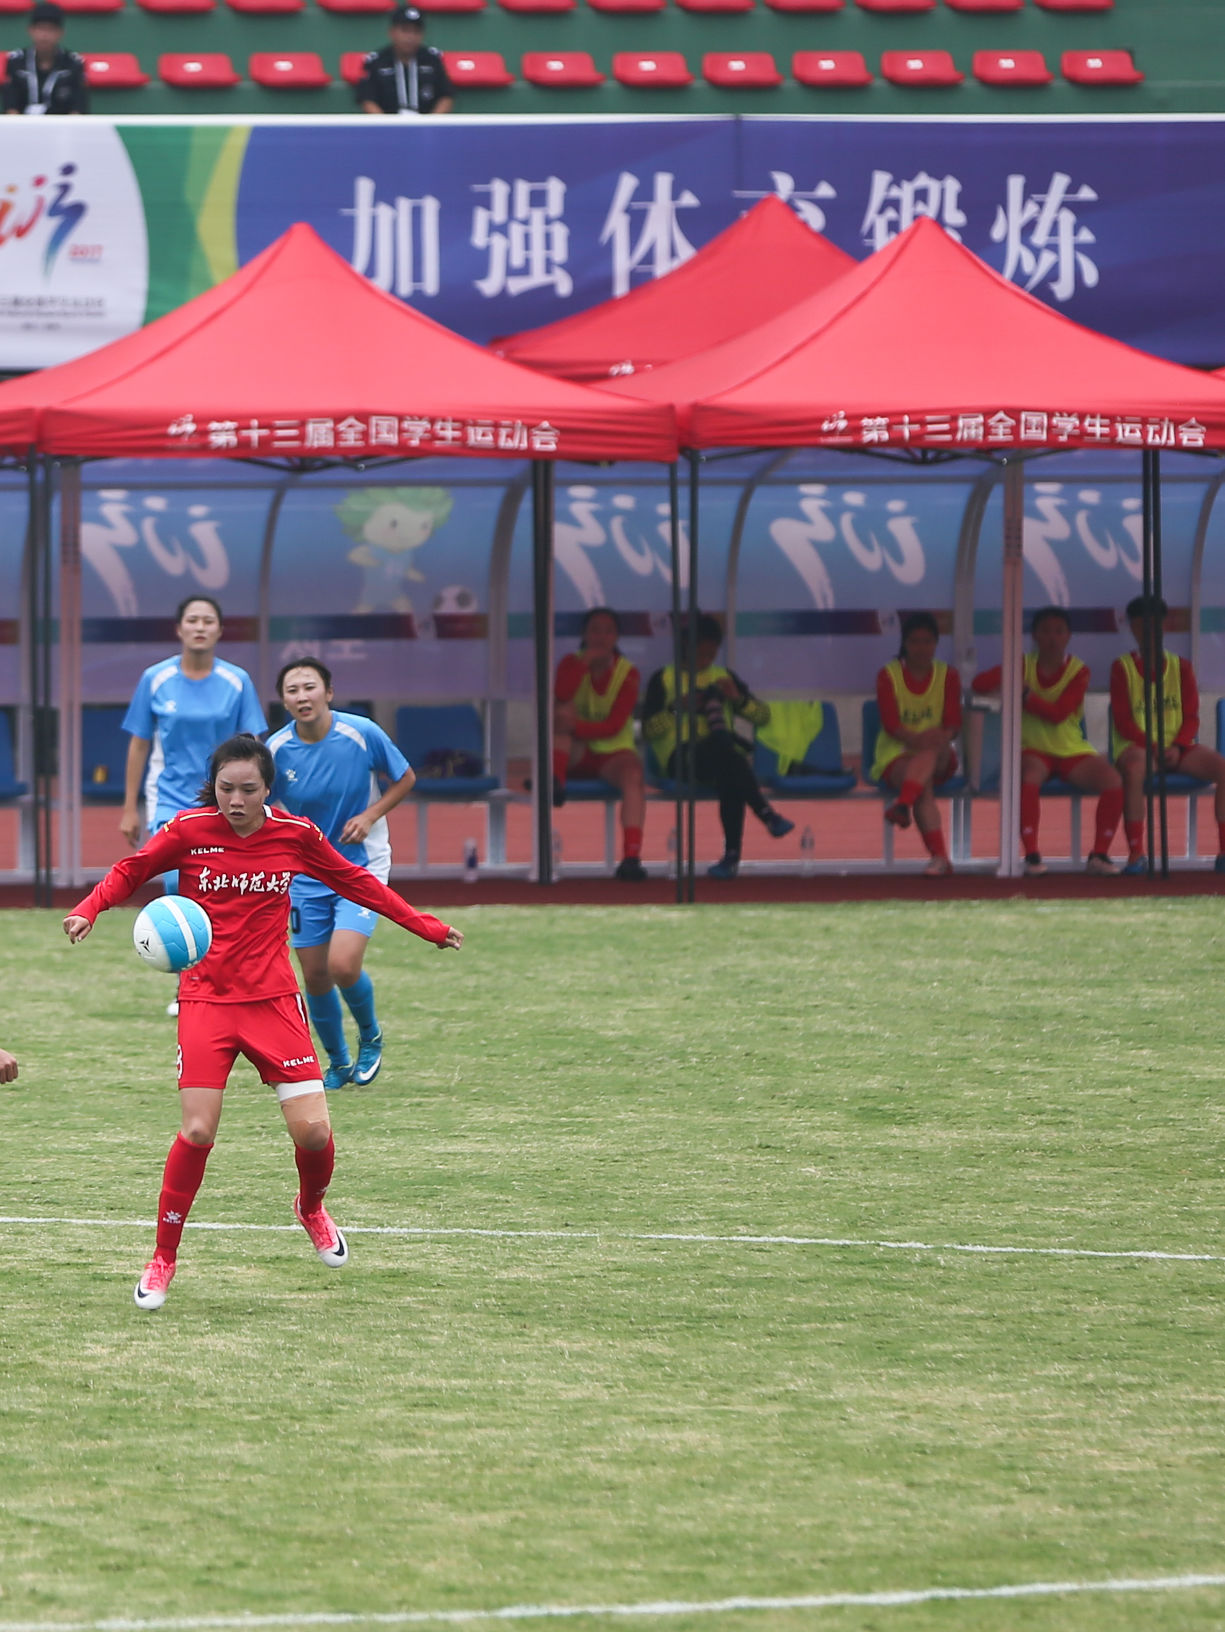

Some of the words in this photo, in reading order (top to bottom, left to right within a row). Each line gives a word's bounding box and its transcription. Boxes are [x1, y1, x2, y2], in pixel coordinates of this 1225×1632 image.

[207, 415, 561, 452] 第十三届全国学生运动会
[860, 410, 1207, 447] 第十三届全国学生运动会
[191, 846, 225, 856] KELME
[198, 865, 292, 896] 东北师范大学
[283, 1055, 315, 1068] KELME
